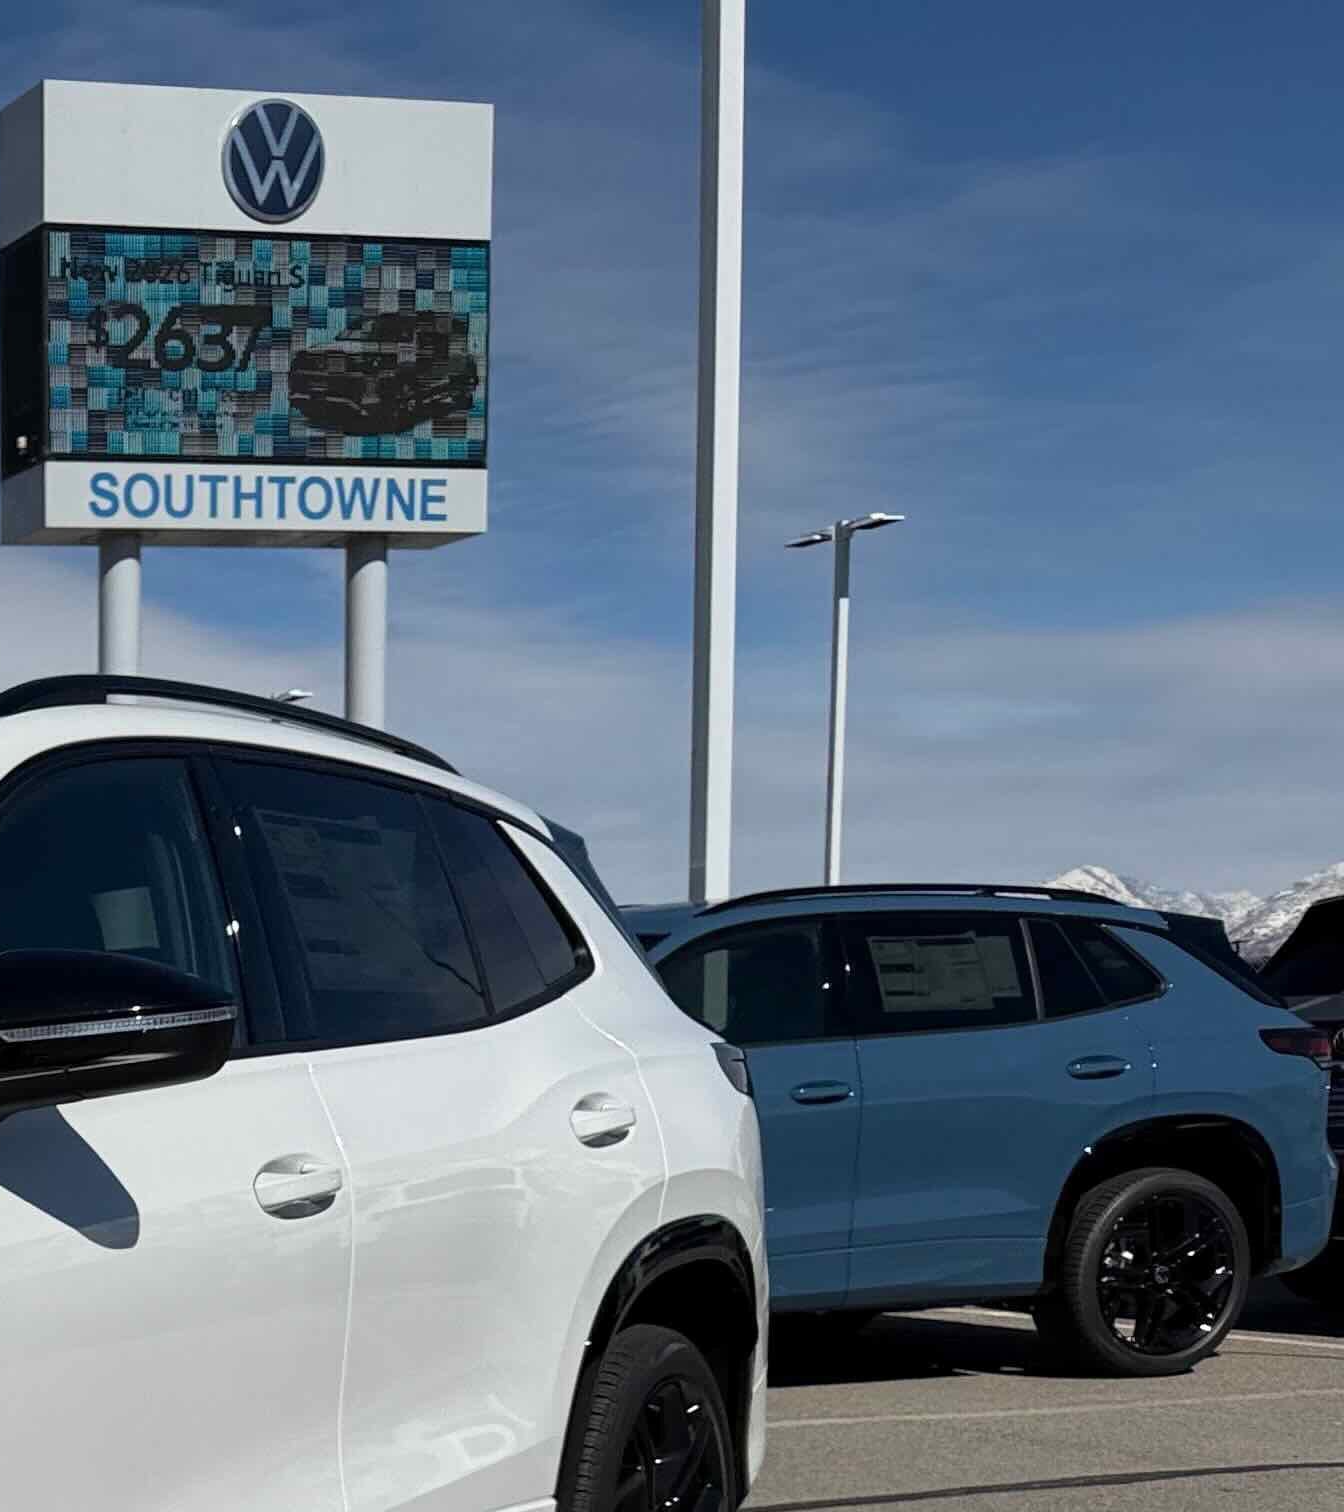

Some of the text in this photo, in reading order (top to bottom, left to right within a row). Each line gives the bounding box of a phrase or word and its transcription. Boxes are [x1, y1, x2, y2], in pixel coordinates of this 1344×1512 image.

[289, 263, 305, 289] S
[87, 302, 274, 372] $2637
[89, 472, 448, 522] SOUTHTOWNE
